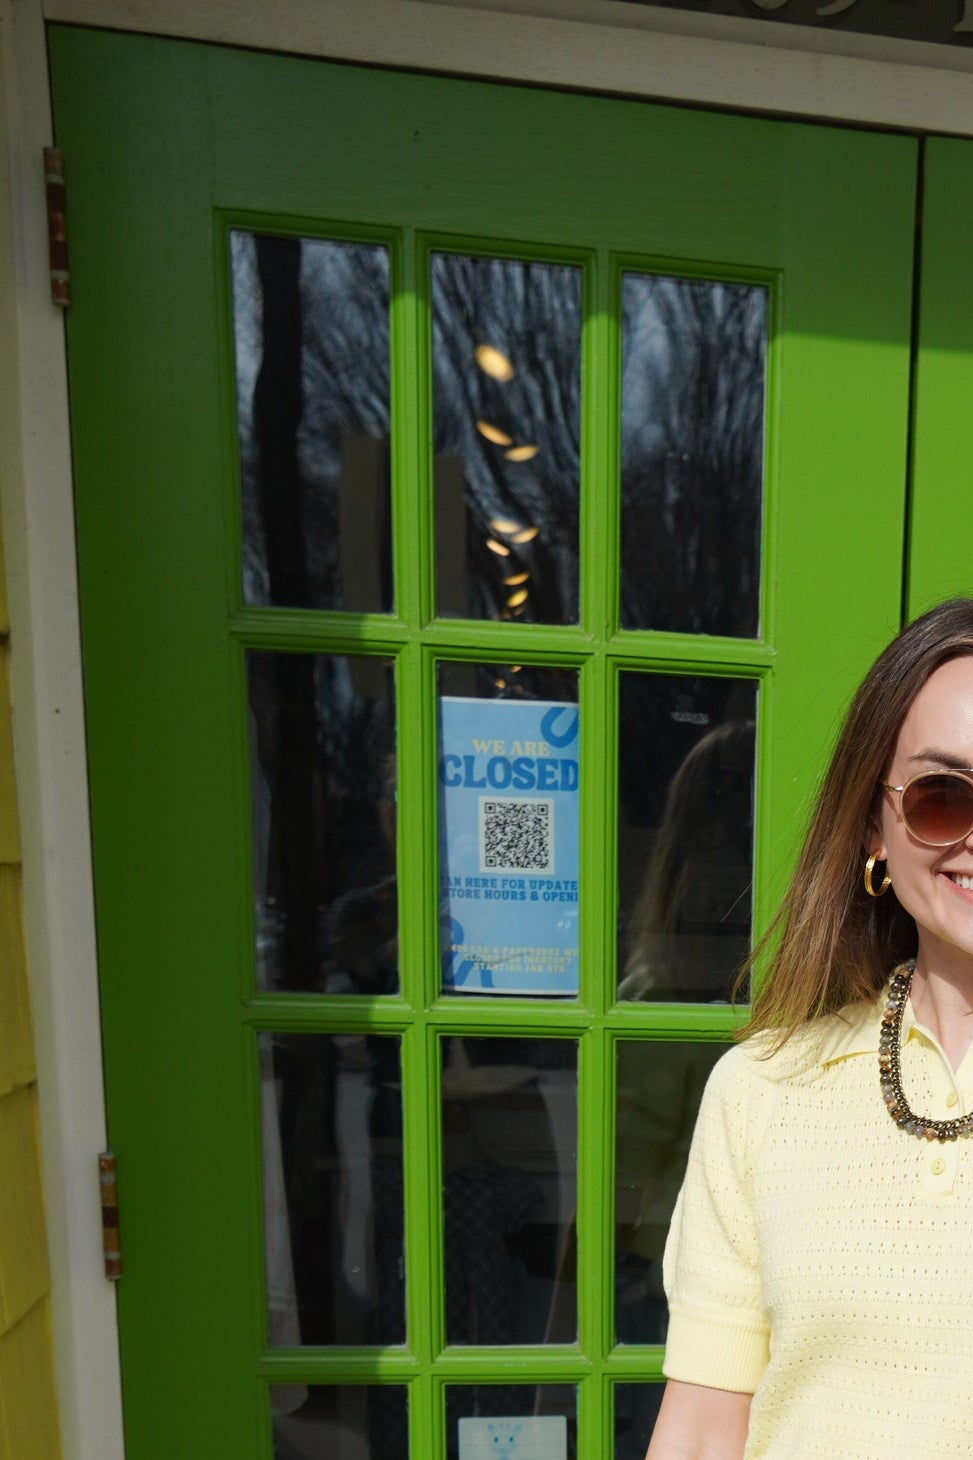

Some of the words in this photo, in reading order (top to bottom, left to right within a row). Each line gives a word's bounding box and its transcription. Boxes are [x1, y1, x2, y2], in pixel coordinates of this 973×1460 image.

[471, 738, 506, 756] WE
[510, 740, 551, 757] ARE
[439, 753, 578, 792] CLOSED
[465, 877, 498, 889] HERE
[501, 878, 526, 890] FOR
[529, 880, 578, 891] UPDATE
[484, 889, 527, 901] HOURS
[530, 891, 539, 901] &
